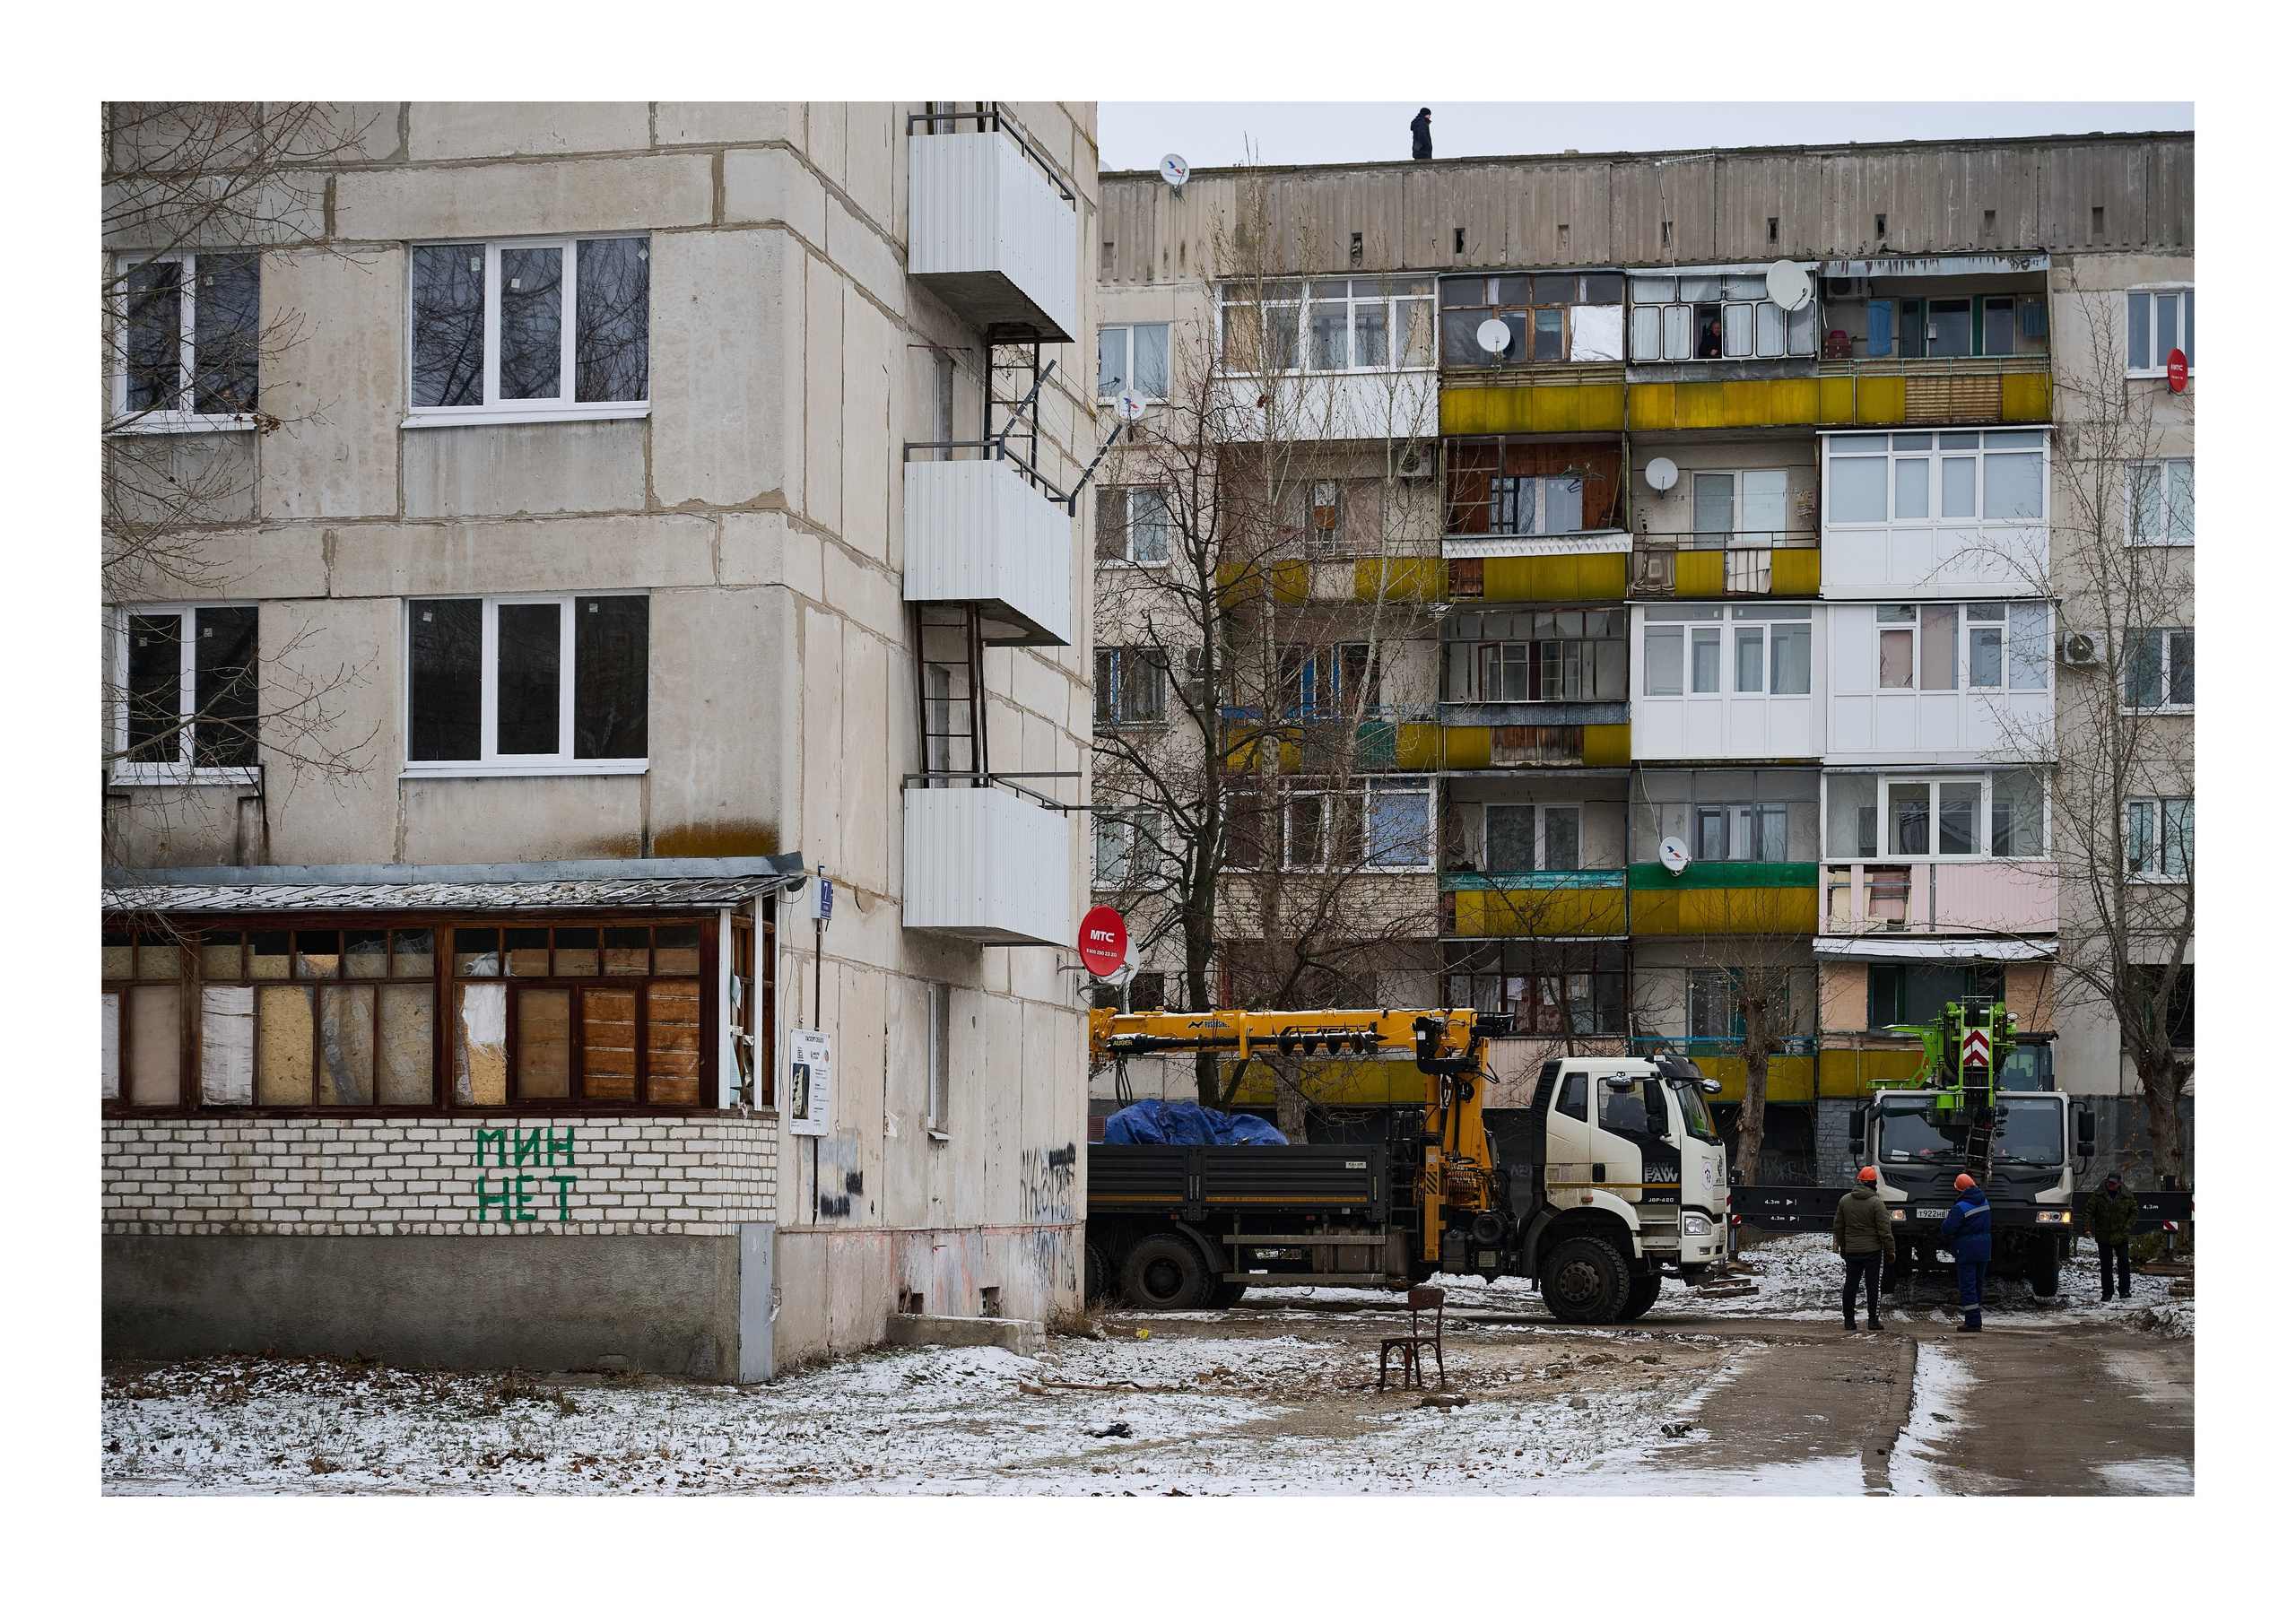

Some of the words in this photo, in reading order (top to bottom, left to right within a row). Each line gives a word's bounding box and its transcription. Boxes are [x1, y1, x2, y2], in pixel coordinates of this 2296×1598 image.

[823, 882, 829, 900] 7
[1090, 929, 1115, 943] МТС
[477, 1127, 574, 1167] МИН
[1644, 1172, 1679, 1182] FAW
[478, 1175, 578, 1225] НЕТ
